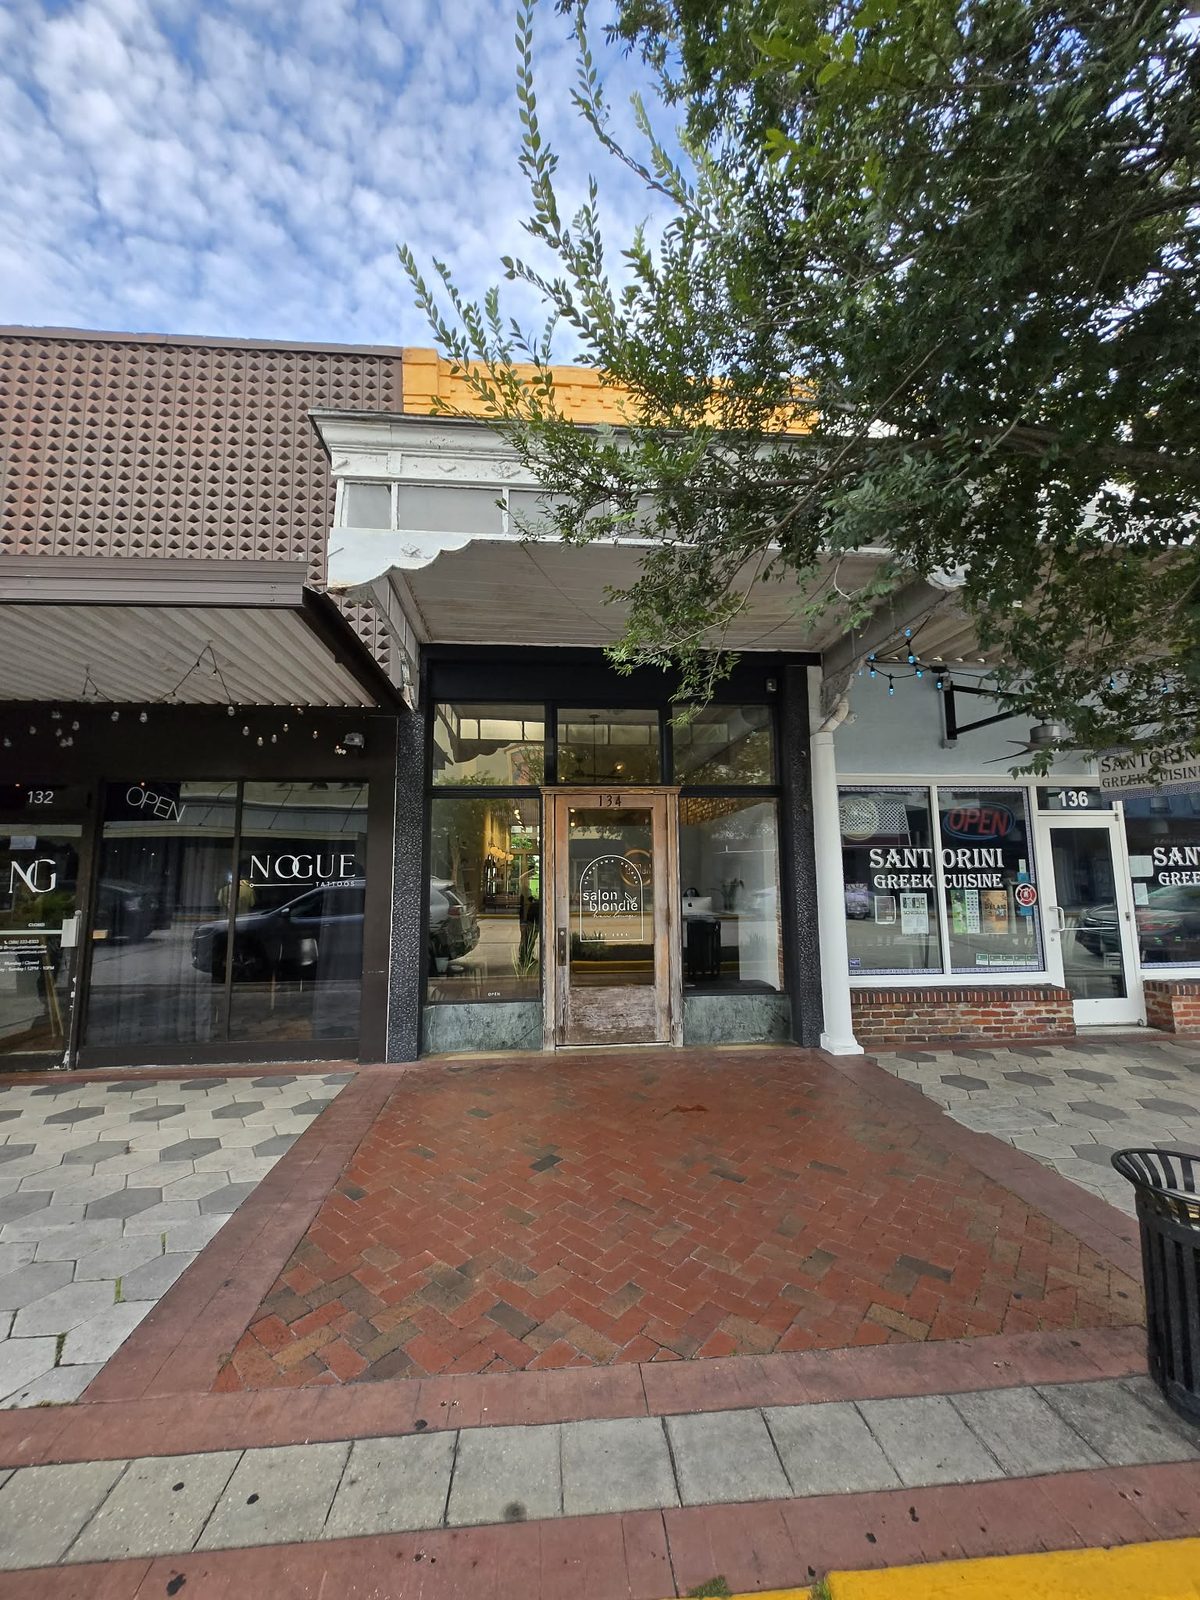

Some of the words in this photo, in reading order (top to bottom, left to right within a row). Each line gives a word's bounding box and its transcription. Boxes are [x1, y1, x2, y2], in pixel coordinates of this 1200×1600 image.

[27, 791, 54, 804] 132
[126, 786, 186, 823] OPEN
[599, 794, 622, 807] 134
[1058, 790, 1089, 807] 136
[950, 807, 1009, 836] OPEN
[249, 854, 356, 879] NOGUE
[869, 848, 1005, 869] SANTORINI
[873, 874, 936, 889] GREEK
[943, 873, 1004, 889] CUISINE
[582, 889, 618, 902] salon
[589, 899, 638, 911] blondie
